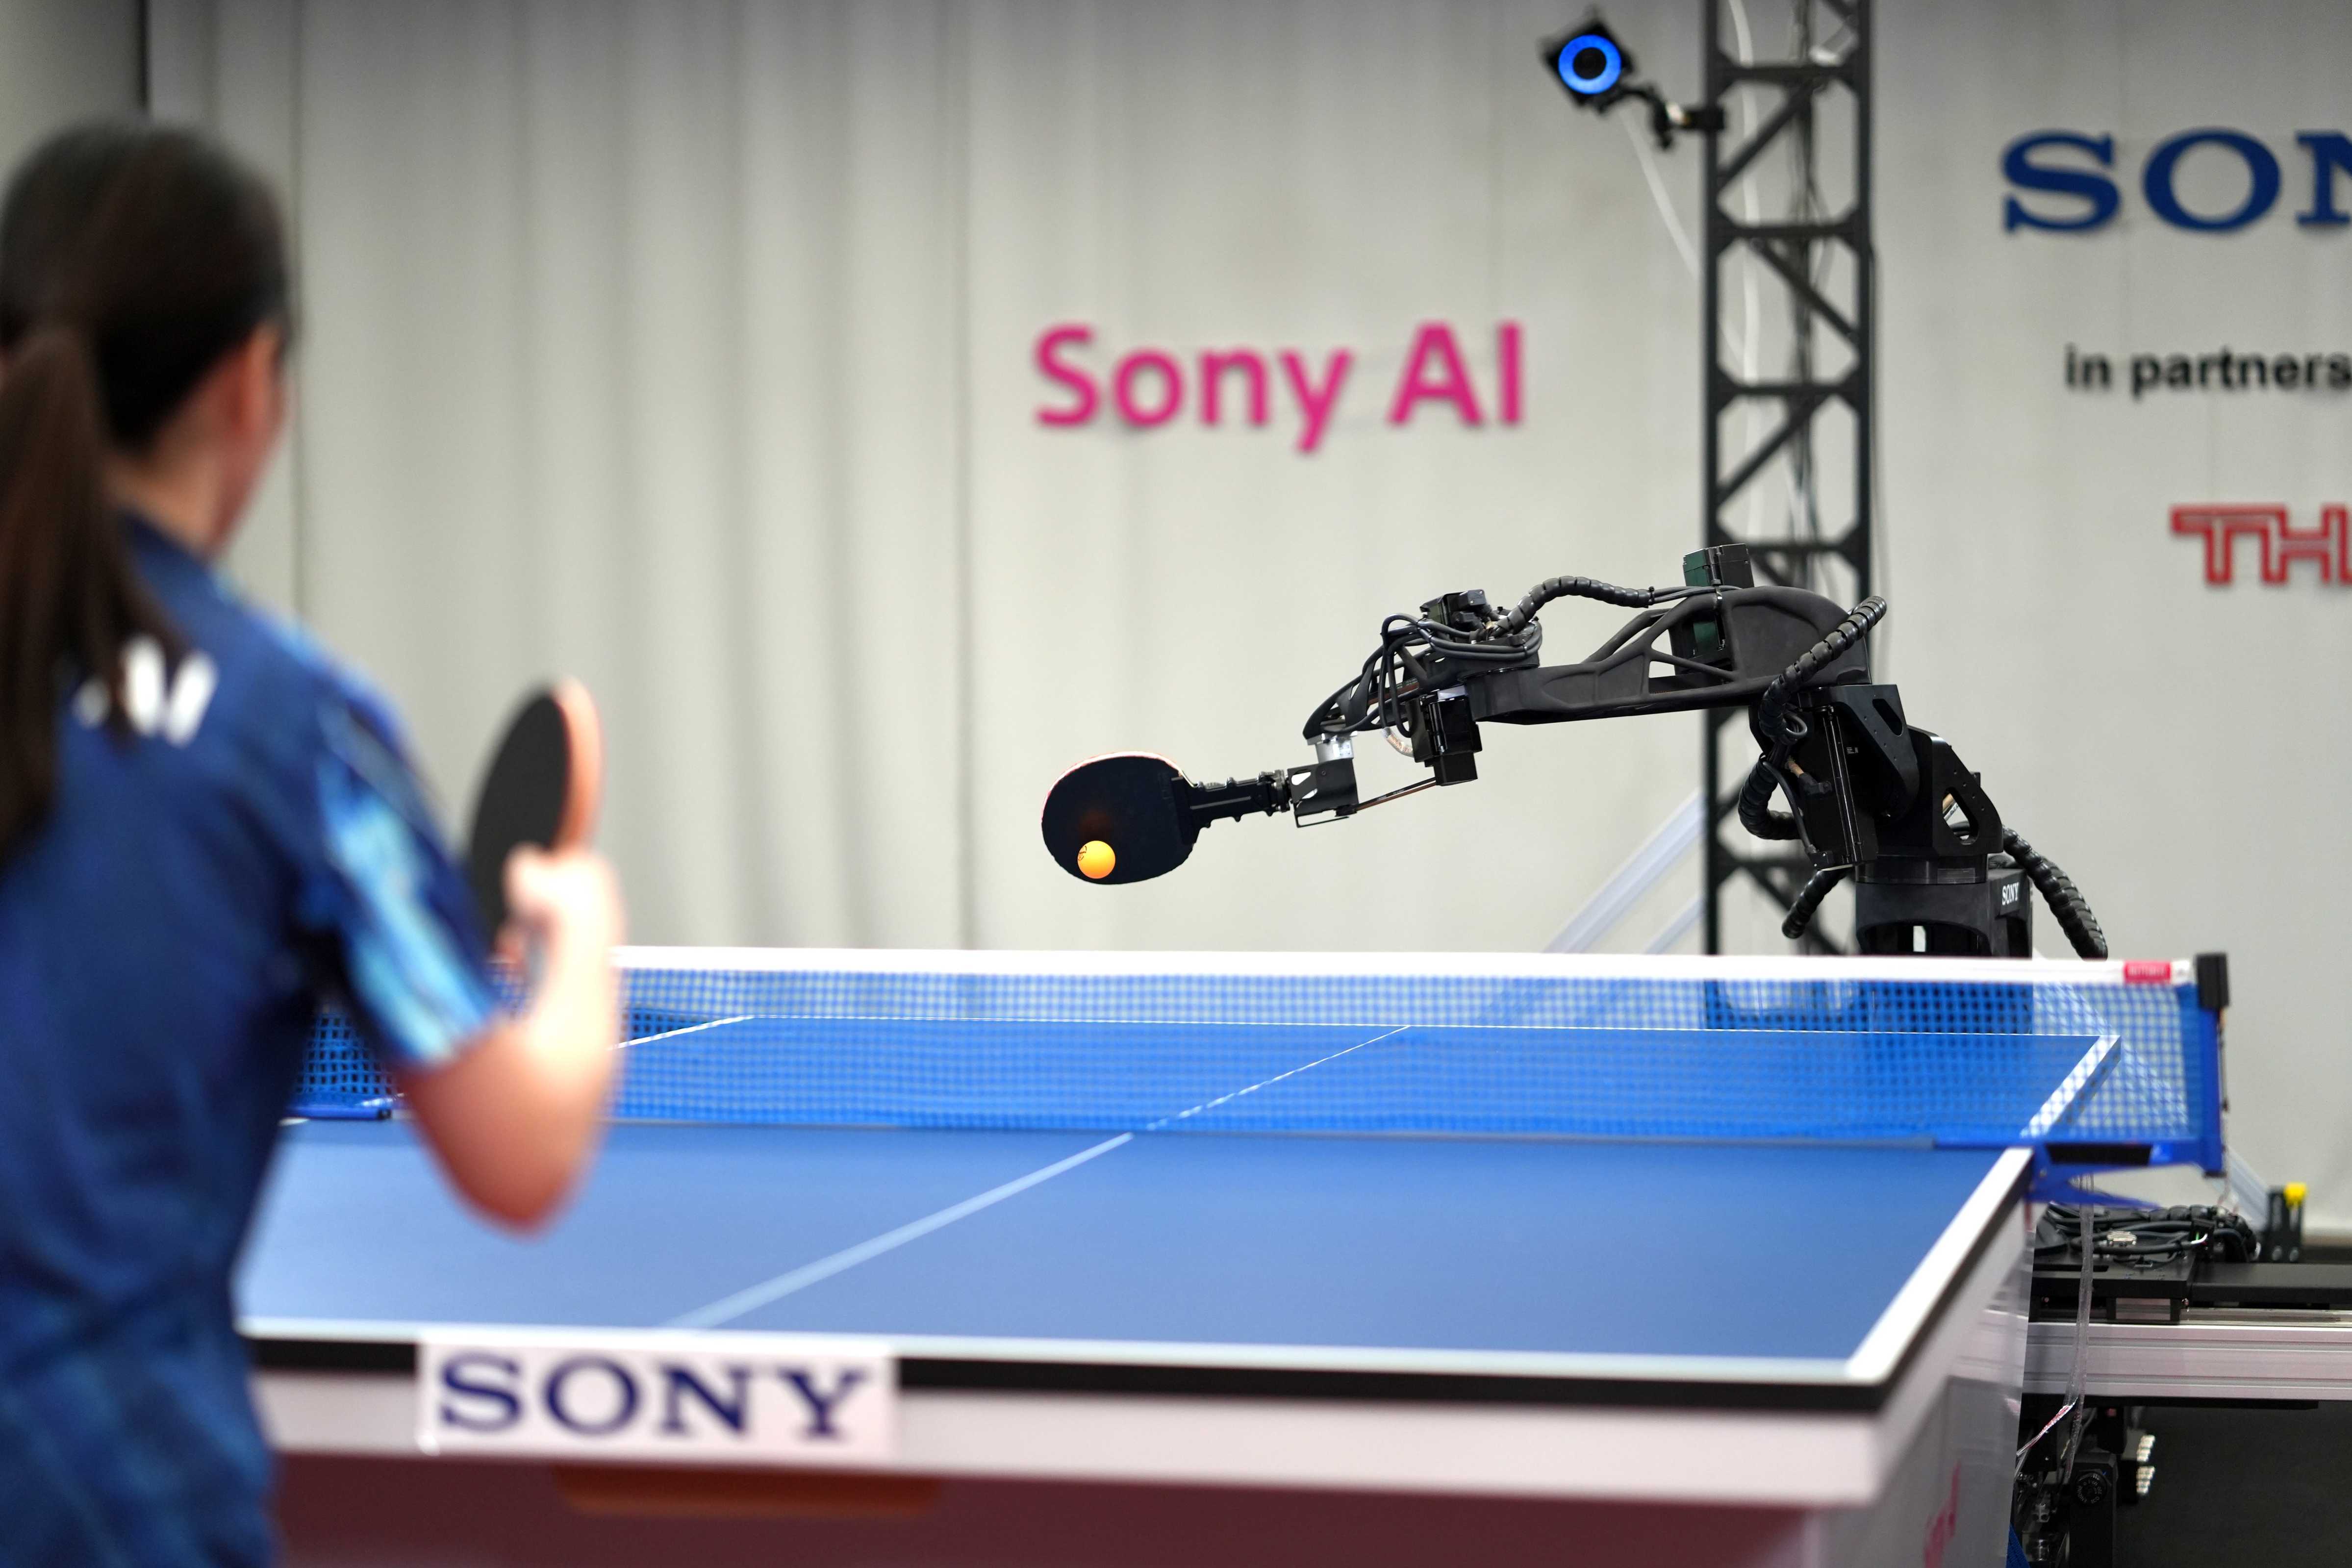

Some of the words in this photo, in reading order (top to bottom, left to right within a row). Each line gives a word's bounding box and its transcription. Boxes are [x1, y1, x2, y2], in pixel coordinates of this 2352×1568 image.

[1035, 322, 1354, 454] Sony
[1388, 321, 1523, 426] AI
[2065, 345, 2112, 390] in
[2130, 347, 2352, 400] partners
[2001, 882, 2019, 906] SONY
[436, 1352, 870, 1442] SONY
